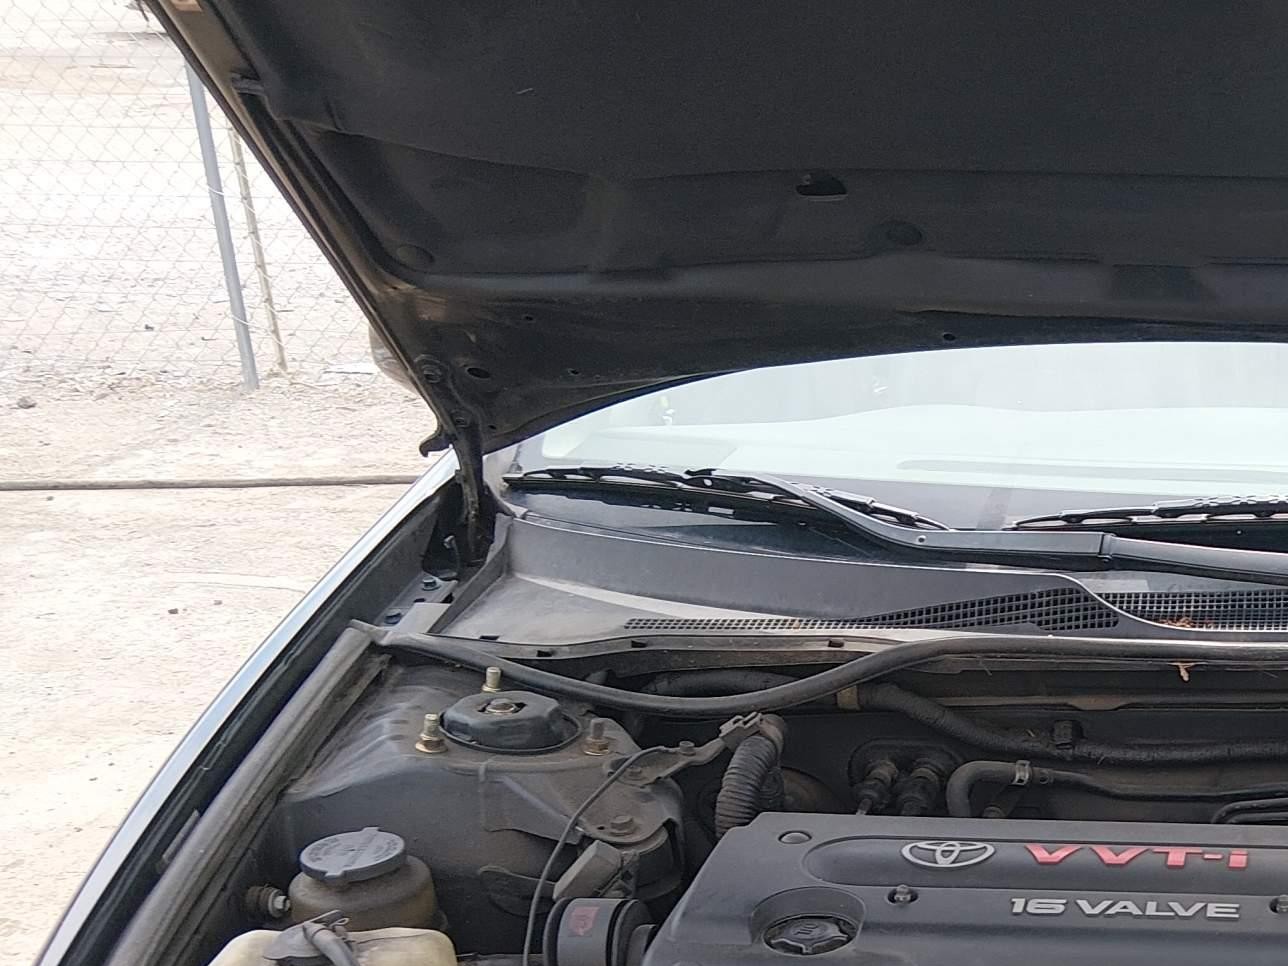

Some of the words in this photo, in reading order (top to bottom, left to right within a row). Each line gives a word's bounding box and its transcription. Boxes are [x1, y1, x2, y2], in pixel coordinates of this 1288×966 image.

[1025, 844, 1248, 869] VVT-i
[1011, 898, 1068, 916] 16
[1076, 900, 1241, 920] VALVE
